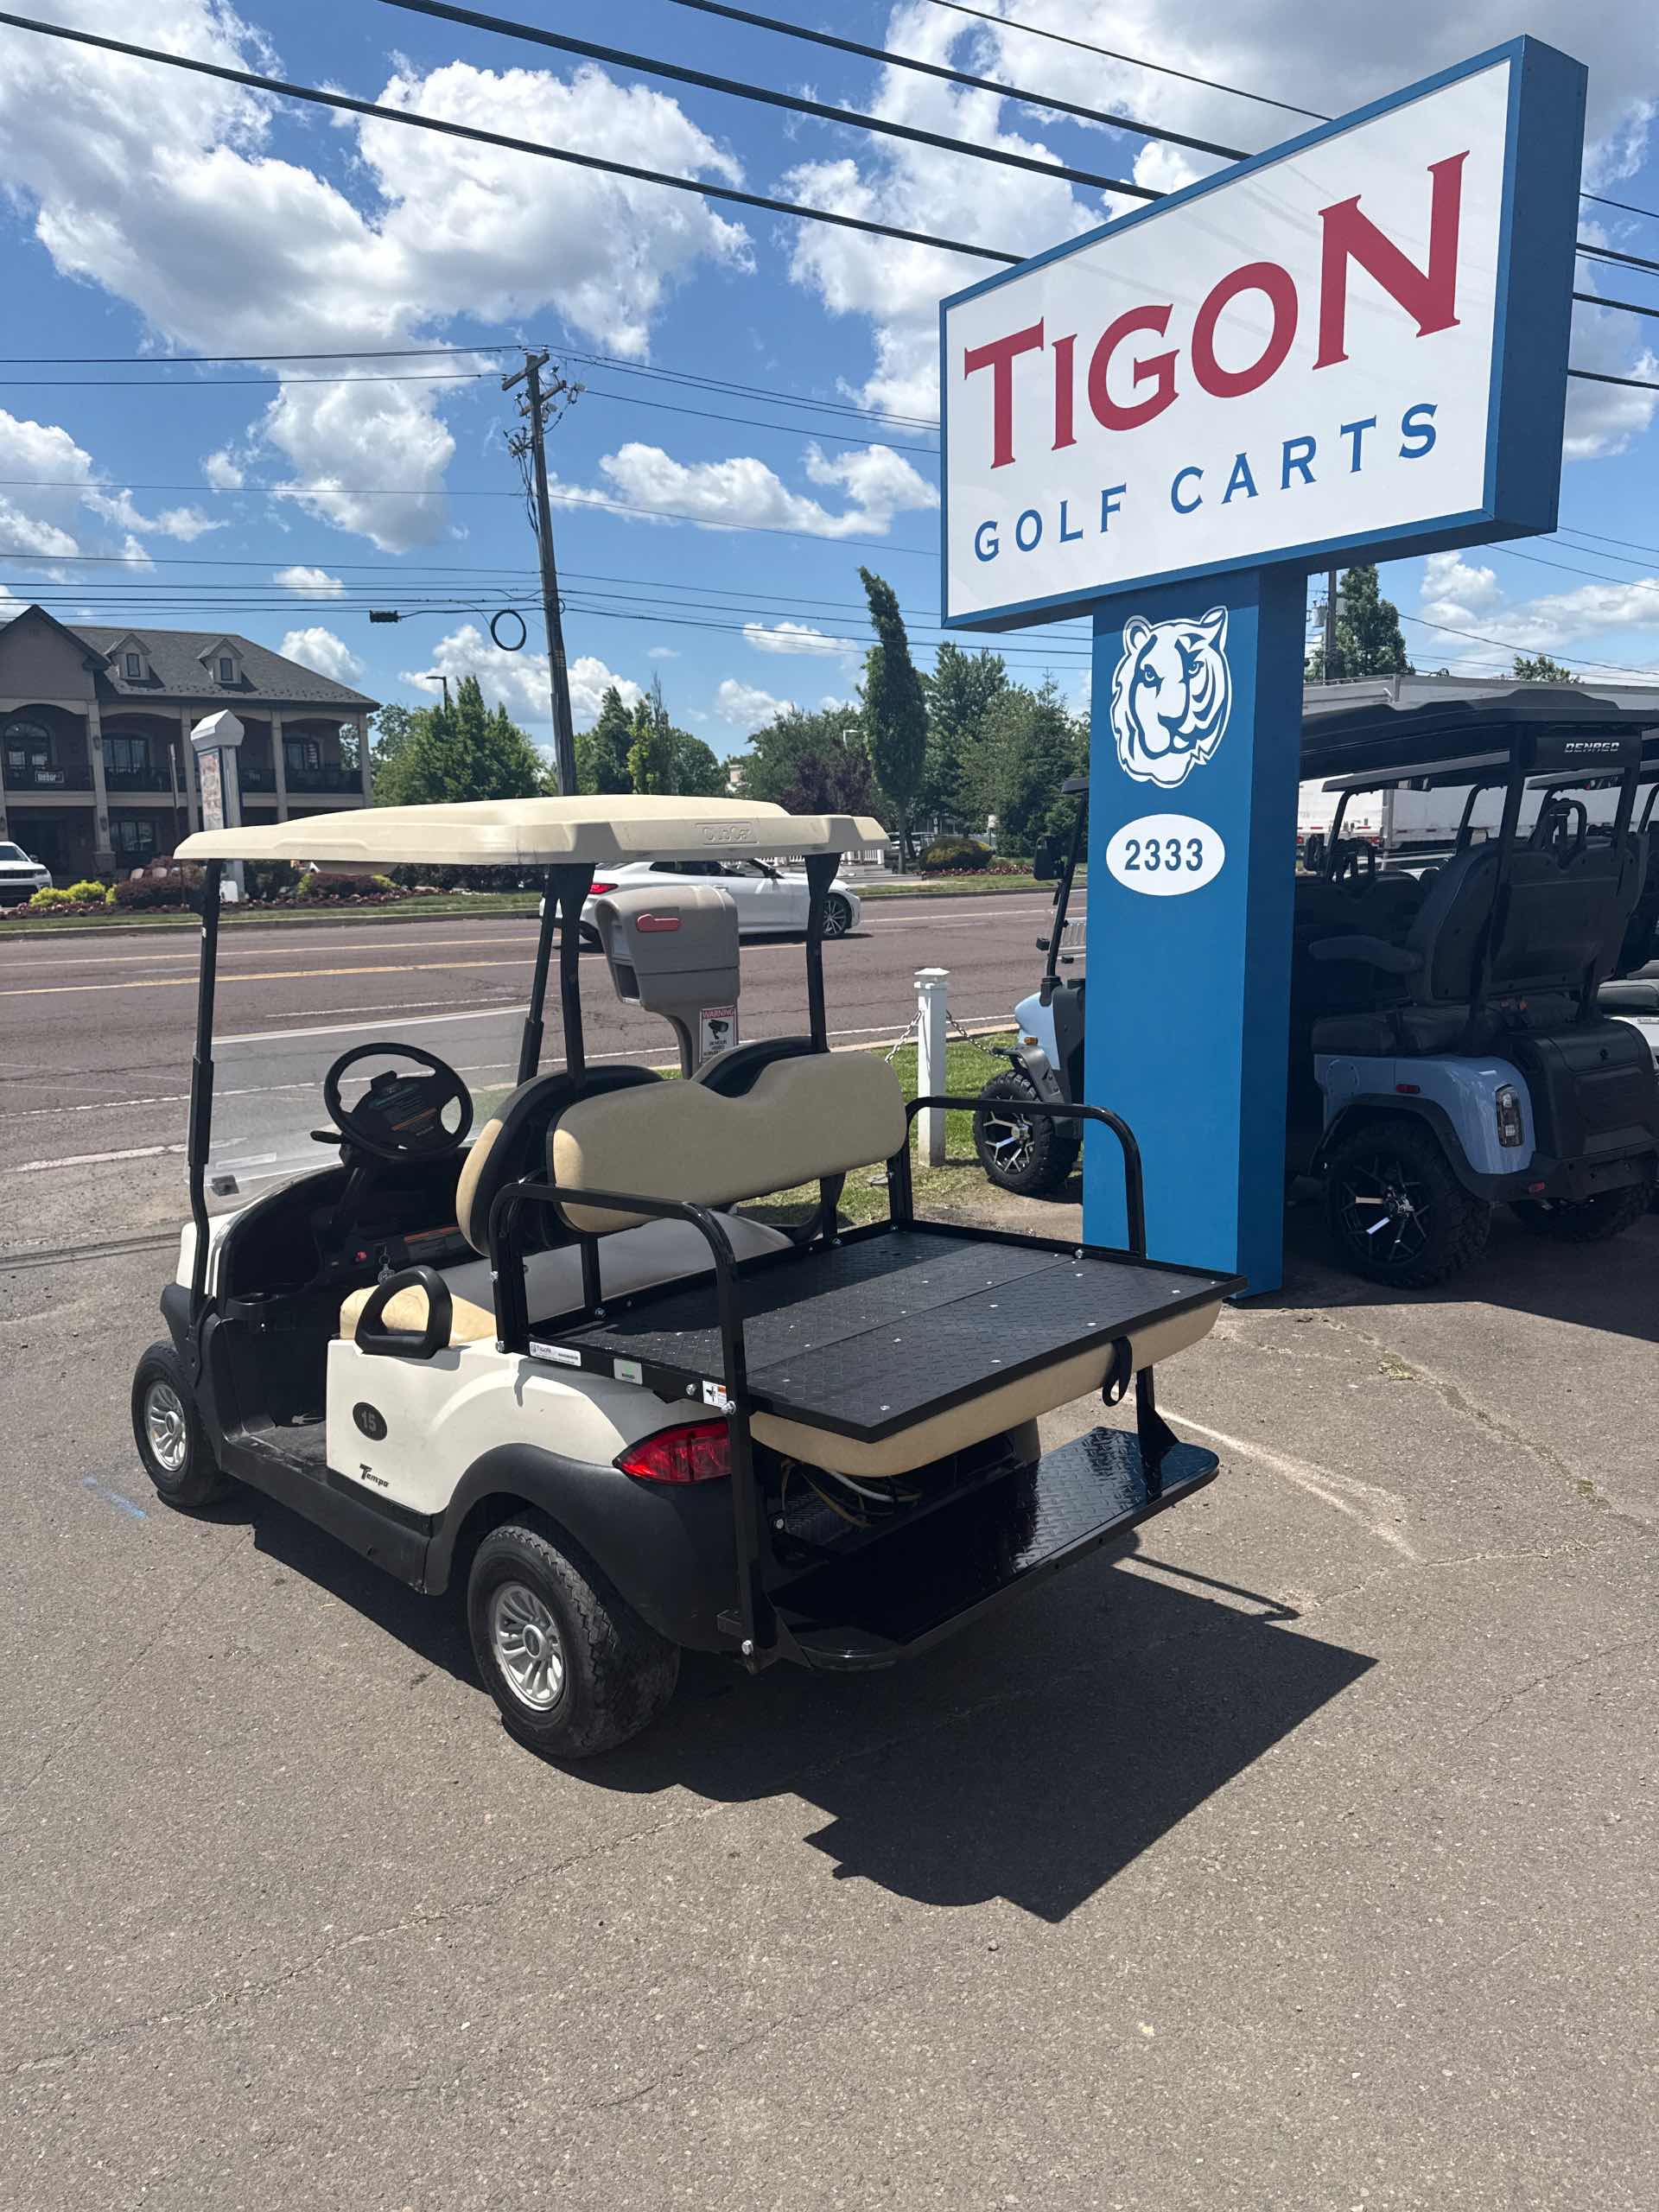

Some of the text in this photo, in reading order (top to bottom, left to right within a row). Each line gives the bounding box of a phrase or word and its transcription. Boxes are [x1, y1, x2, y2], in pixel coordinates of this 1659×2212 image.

[964, 151, 1466, 467] TIGON
[974, 403, 1437, 563] GOLF CARTS
[1124, 838, 1204, 872] 2333
[361, 1410, 377, 1432] 15
[359, 1463, 390, 1488] Tempo
